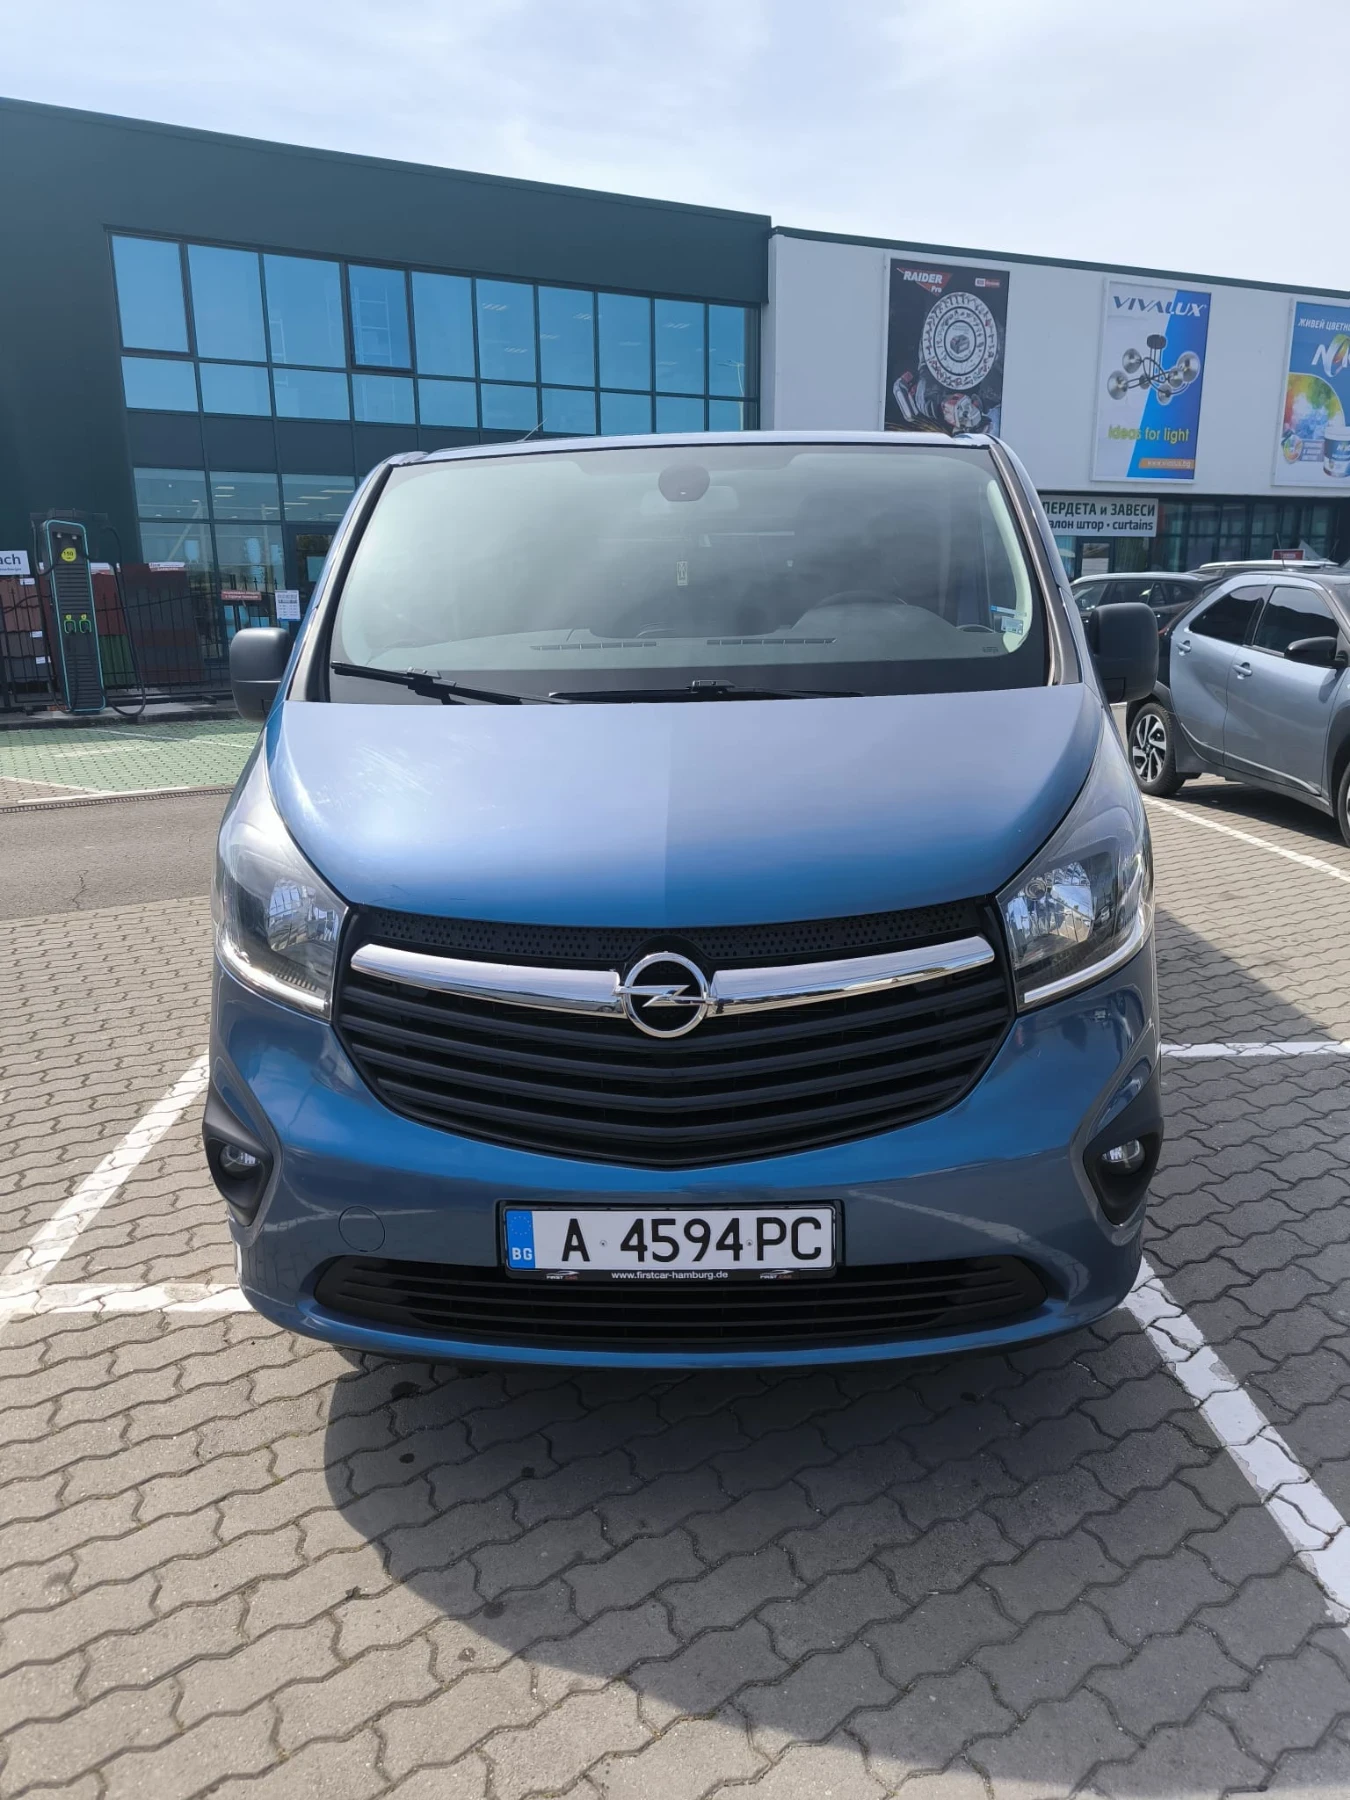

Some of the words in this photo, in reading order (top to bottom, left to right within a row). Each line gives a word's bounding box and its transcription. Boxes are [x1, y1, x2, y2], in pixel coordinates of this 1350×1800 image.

[903, 270, 943, 284] RAIDER
[1113, 295, 1204, 317] VIVALUX
[1298, 318, 1325, 330] ЖИВЕЙ
[1145, 427, 1161, 441] for
[1164, 428, 1190, 444] light
[1043, 501, 1097, 517] ПЕРДЕТА
[1100, 506, 1107, 516] и
[1110, 503, 1155, 517] ЗАВЕСИ
[1049, 520, 1074, 529] алон
[1076, 521, 1104, 532] штор
[1112, 519, 1153, 531] curtains
[561, 1218, 591, 1262] A
[511, 1247, 533, 1261] BG
[611, 1271, 728, 1280] www.firstcar-hamburg.de
